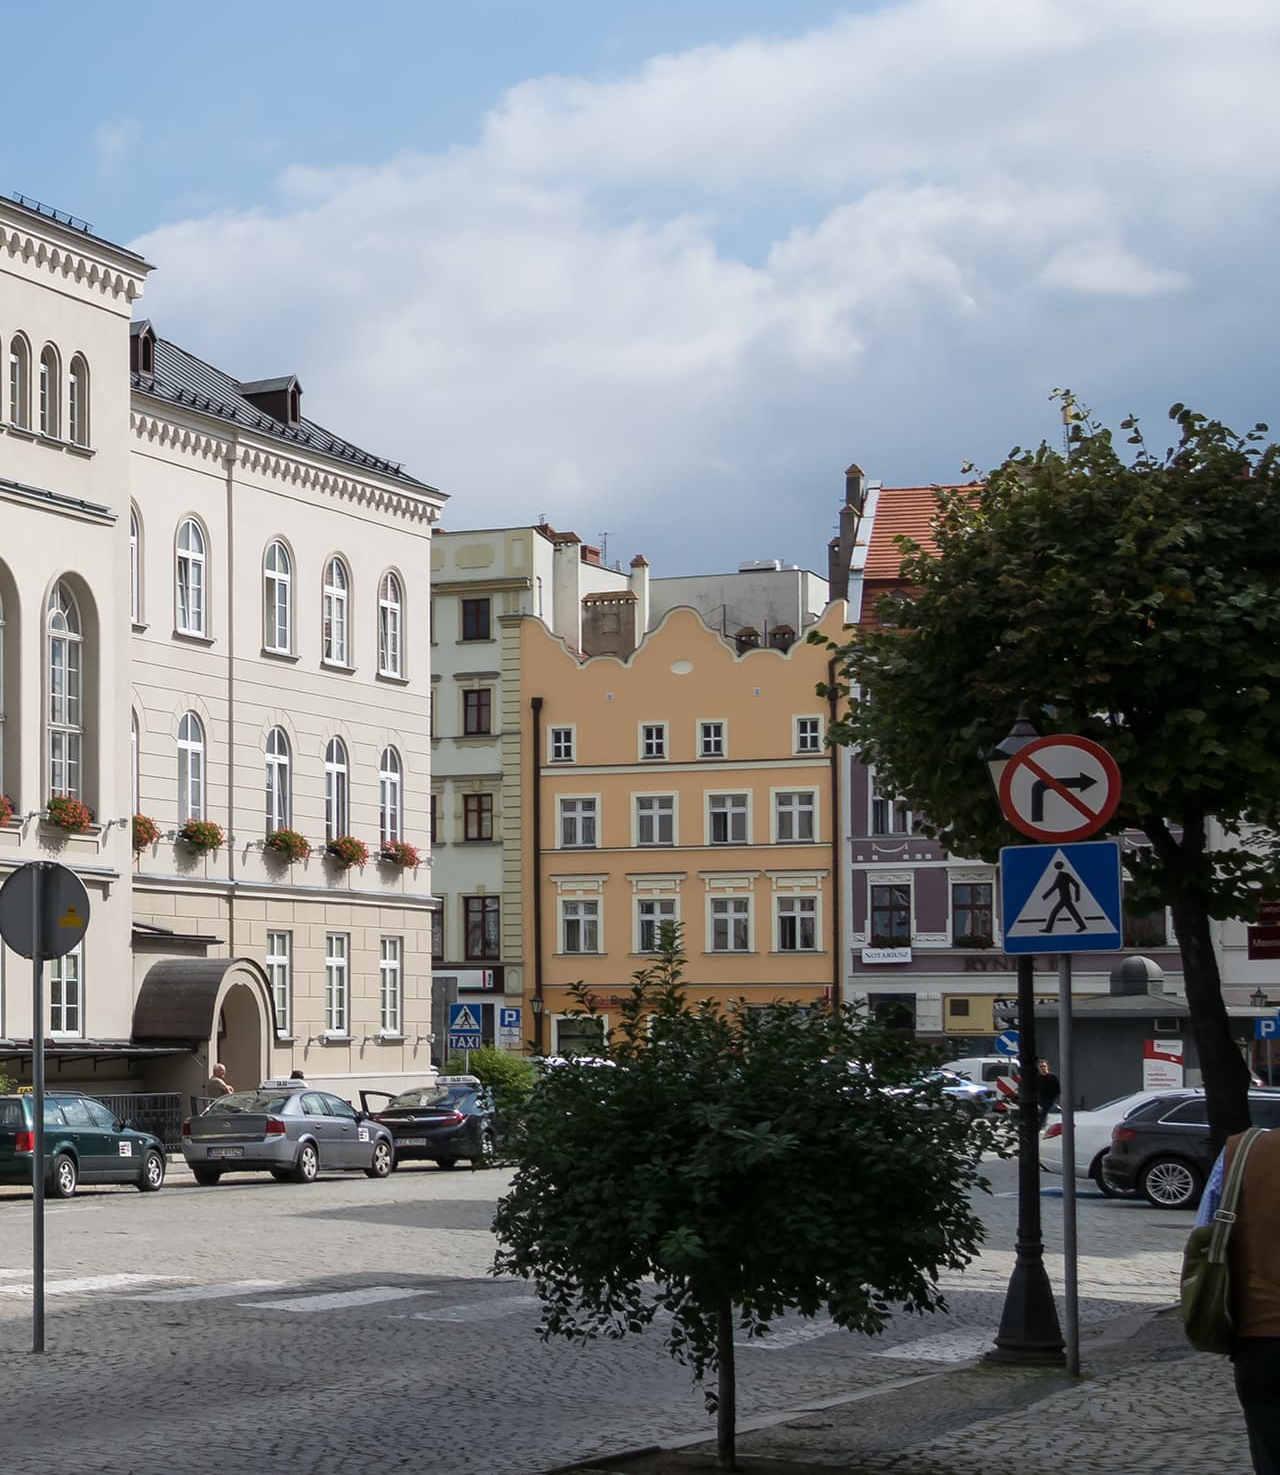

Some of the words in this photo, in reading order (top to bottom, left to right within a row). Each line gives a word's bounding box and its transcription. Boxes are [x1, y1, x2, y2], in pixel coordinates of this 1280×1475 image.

[504, 1010, 517, 1026] P
[1260, 1020, 1276, 1037] P
[450, 1036, 481, 1048] TAXI
